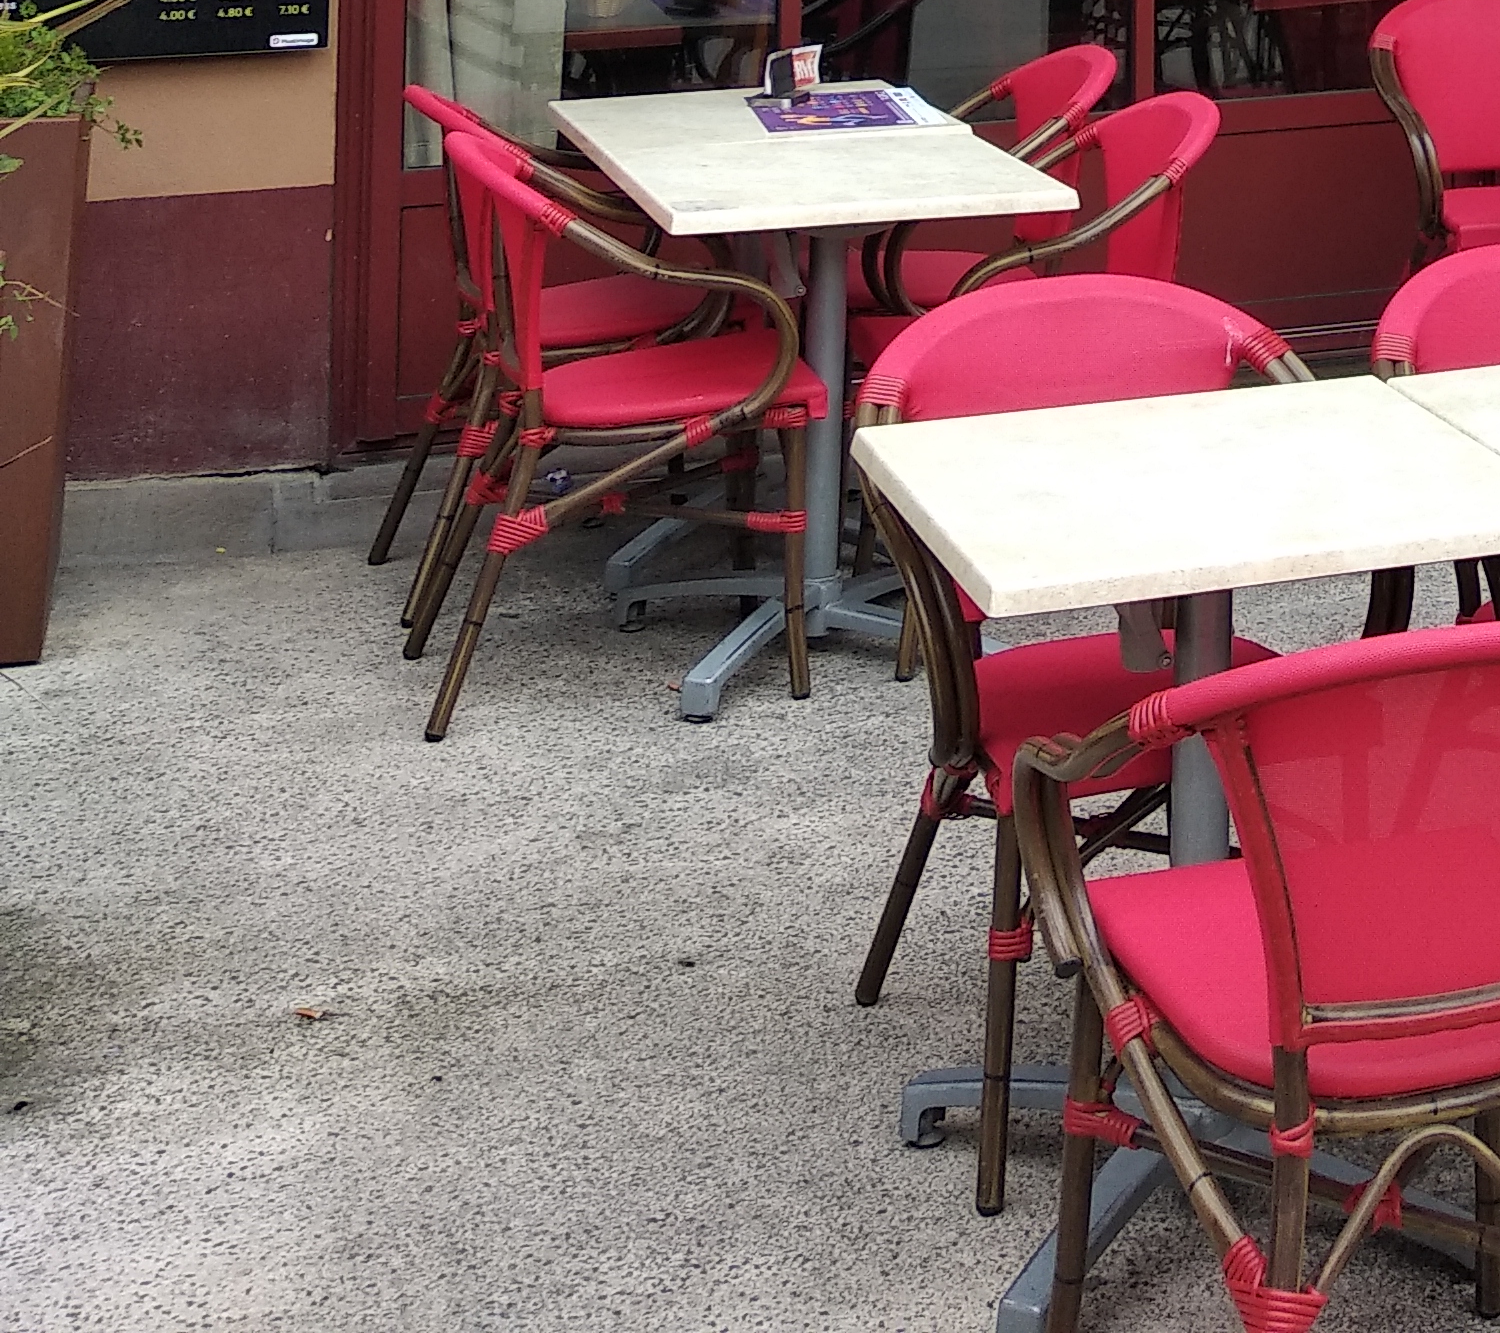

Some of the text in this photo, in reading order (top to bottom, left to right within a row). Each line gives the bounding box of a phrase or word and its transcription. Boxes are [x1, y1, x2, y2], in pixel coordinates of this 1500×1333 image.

[158, 9, 186, 21] 4.00
[217, 7, 243, 18] 4.80
[278, 5, 300, 15] 7.10
